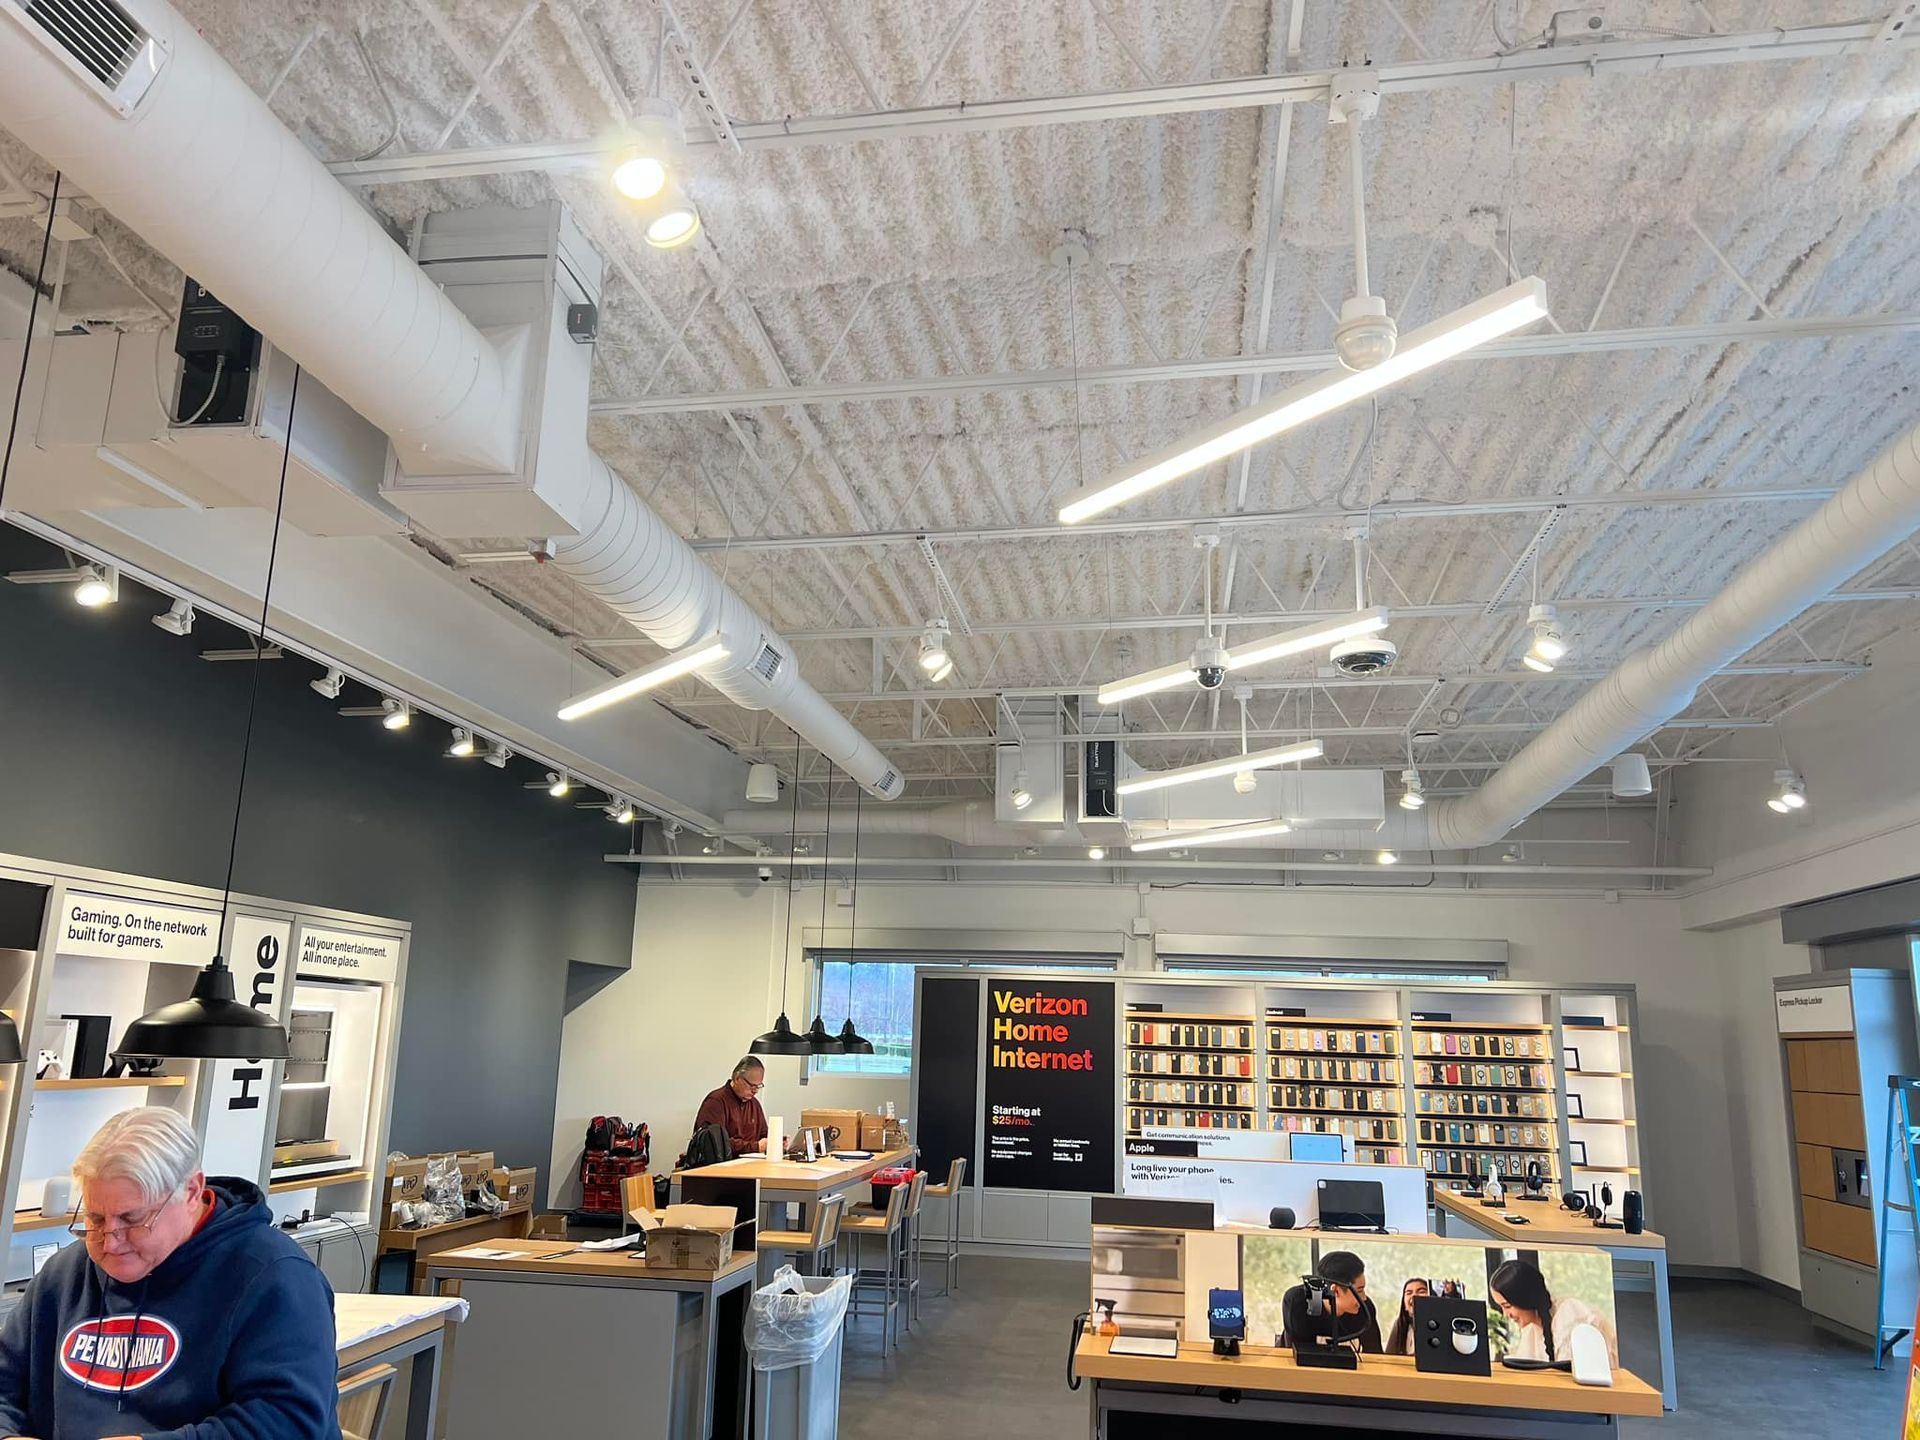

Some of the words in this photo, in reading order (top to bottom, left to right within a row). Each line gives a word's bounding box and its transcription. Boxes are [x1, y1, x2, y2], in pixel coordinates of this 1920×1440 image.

[71, 906, 122, 929] Gaming.
[125, 913, 142, 929] On
[143, 916, 161, 931] the
[163, 921, 208, 936] network
[67, 925, 96, 942] built
[98, 928, 116, 944] for
[117, 933, 163, 949] gamers.
[304, 935, 316, 948] All
[316, 939, 334, 951] your
[335, 942, 387, 958] entertainment.
[302, 950, 314, 963] All
[314, 951, 322, 963] in
[322, 955, 337, 965] one
[337, 955, 360, 968] place.
[994, 990, 1088, 1016] Verizon
[228, 935, 279, 1110] Hme
[994, 1017, 1069, 1042] Home
[993, 1045, 1093, 1070] Internet
[992, 1105, 1030, 1118] Starting
[1031, 1107, 1041, 1116] at
[1128, 1142, 1155, 1153] Apple
[1158, 1132, 1203, 1140] communication
[1131, 1163, 1152, 1173] Long
[1153, 1164, 1167, 1172] live
[1169, 1166, 1187, 1174] your
